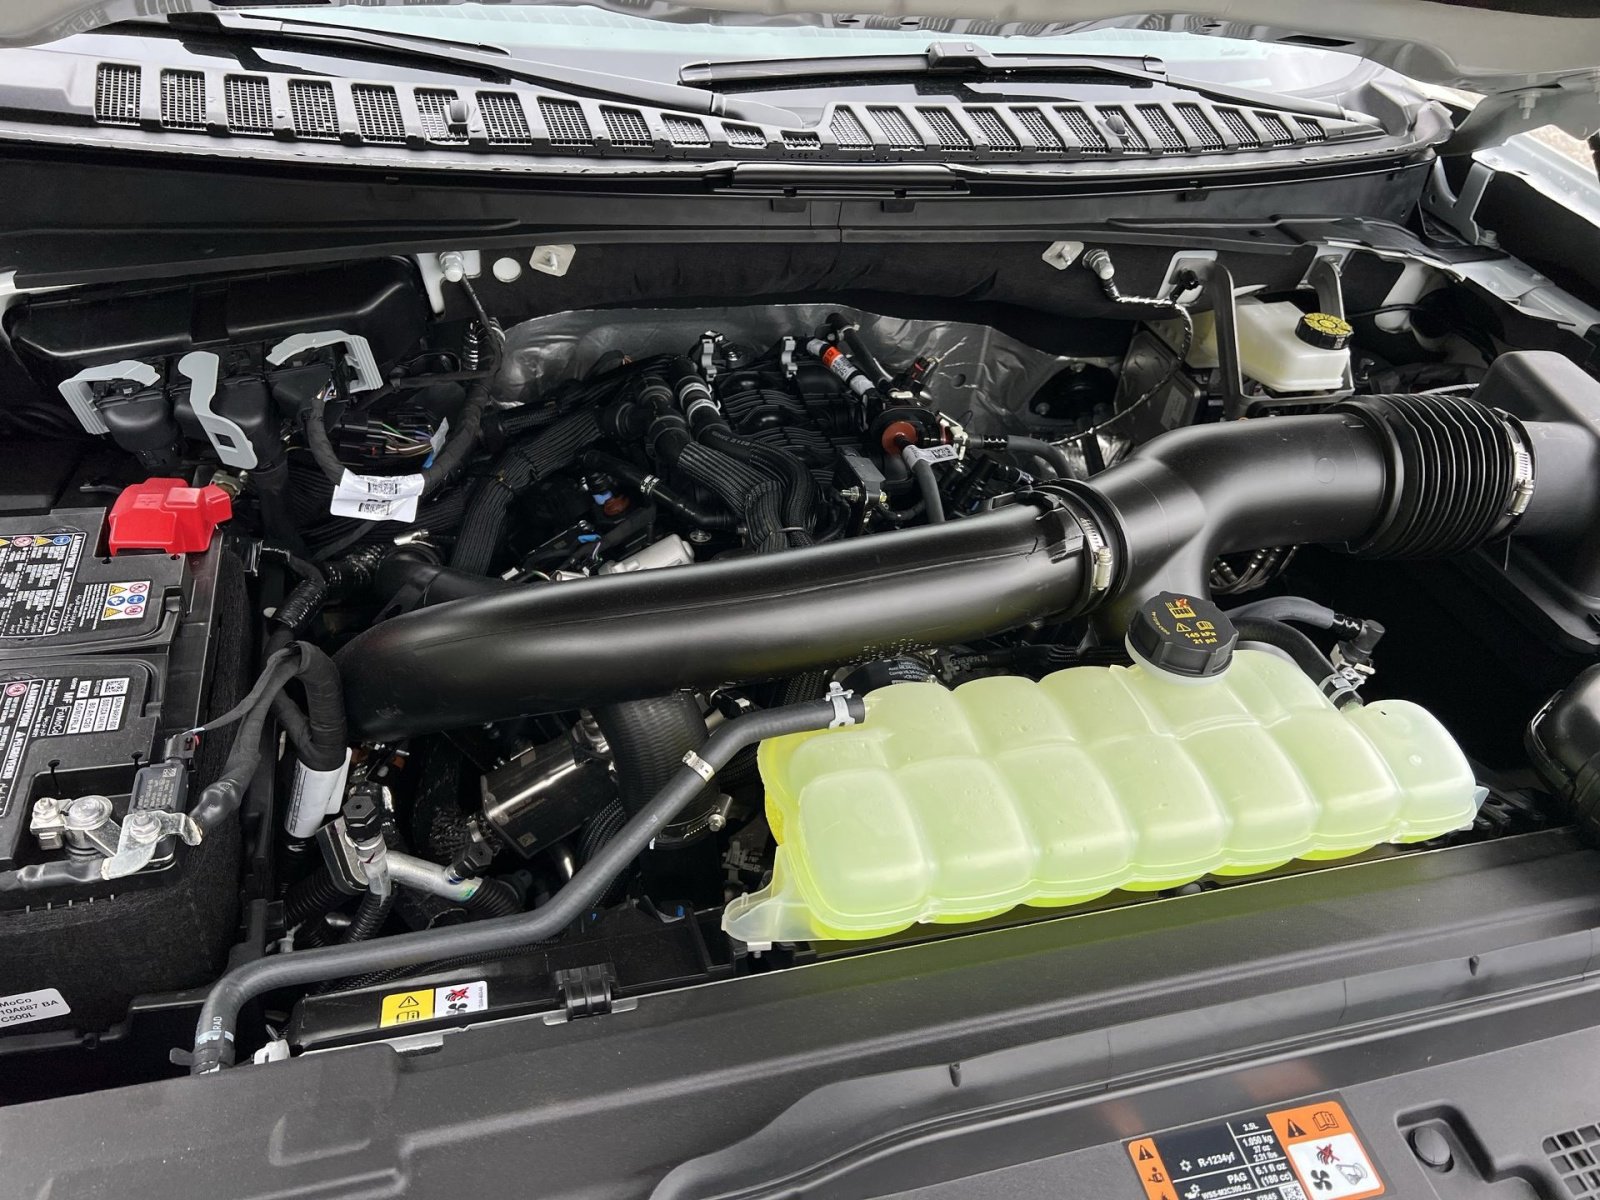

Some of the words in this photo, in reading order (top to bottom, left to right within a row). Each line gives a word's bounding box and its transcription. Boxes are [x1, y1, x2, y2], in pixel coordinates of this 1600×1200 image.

[42, 1000, 59, 1008] BA
[212, 1016, 222, 1030] RAD
[1242, 1122, 1259, 1131] 3.5L
[1262, 1134, 1274, 1144] kg
[1197, 1152, 1235, 1168] R-1234yf
[1255, 1165, 1268, 1175] 6.1
[1268, 1164, 1276, 1172] fl
[1227, 1172, 1247, 1184] PAG
[1260, 1176, 1279, 1186] (180
[1280, 1172, 1293, 1181] cc)
